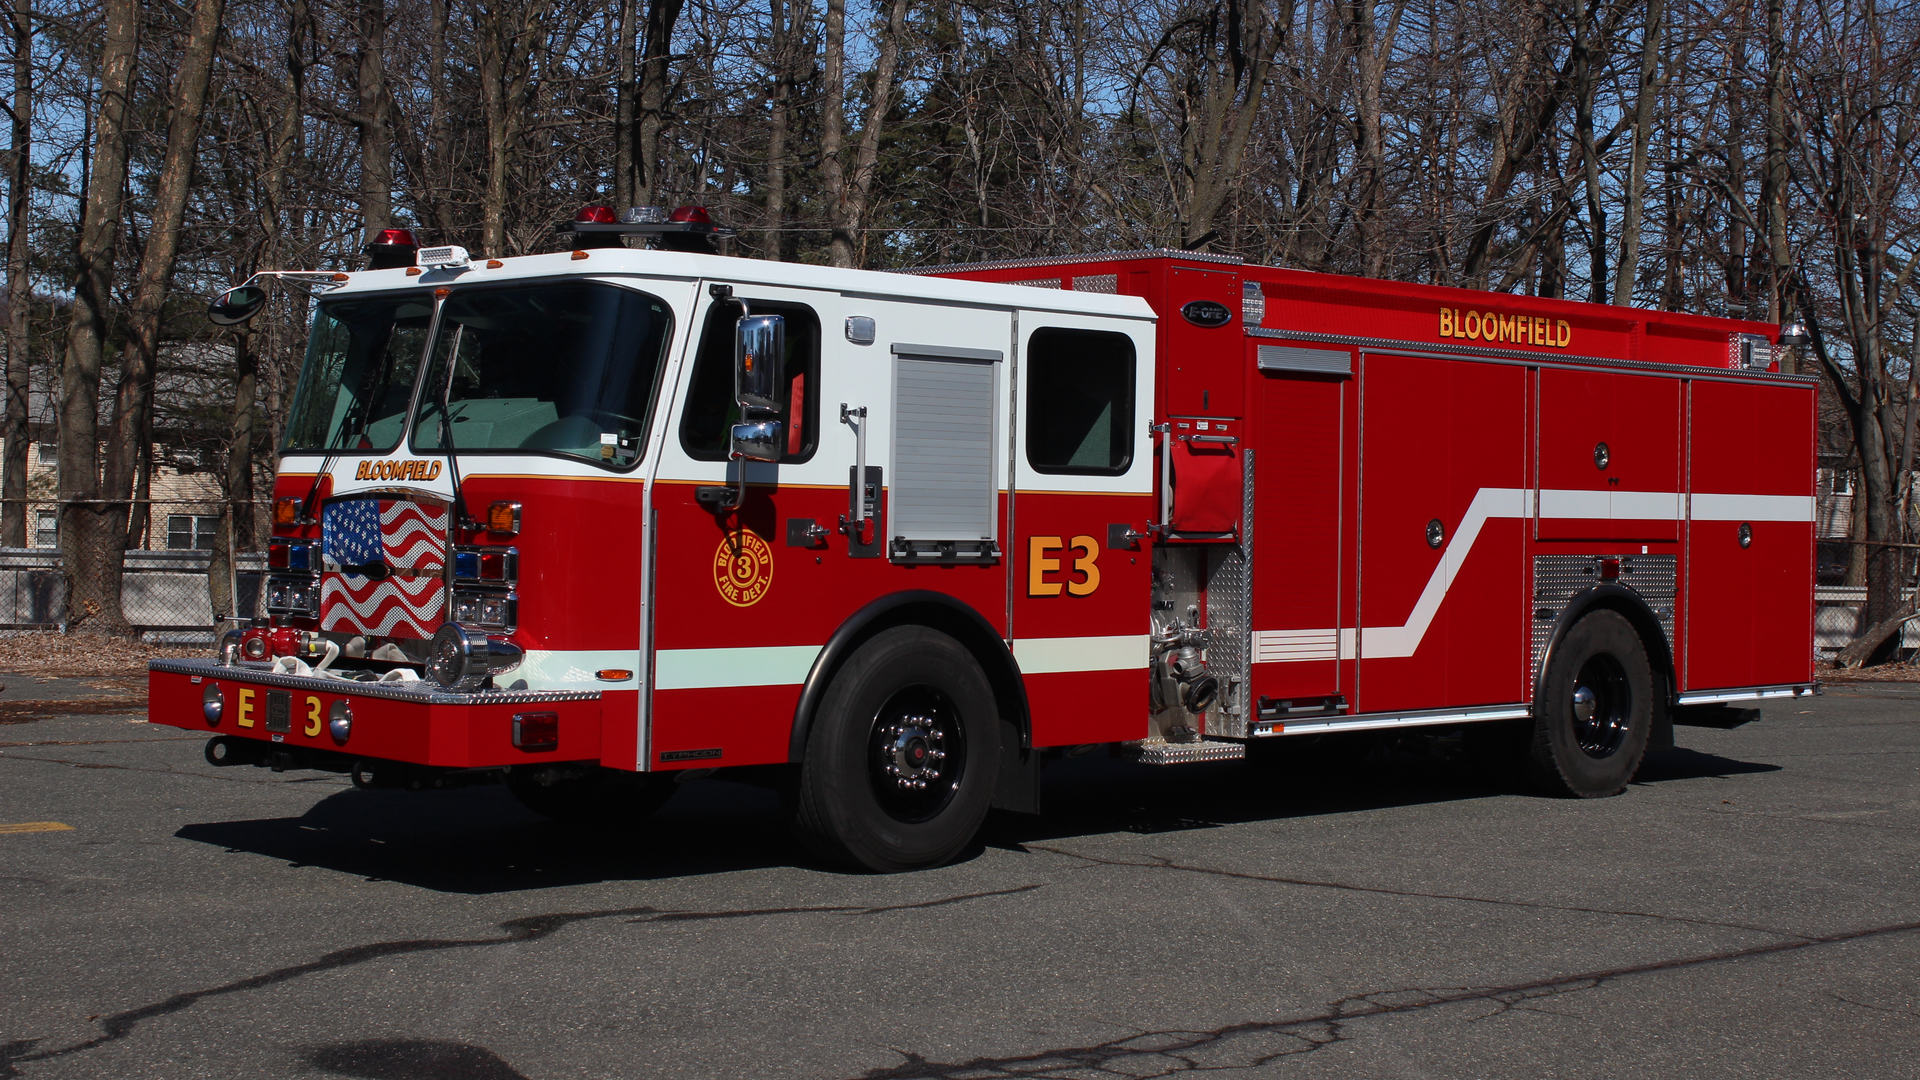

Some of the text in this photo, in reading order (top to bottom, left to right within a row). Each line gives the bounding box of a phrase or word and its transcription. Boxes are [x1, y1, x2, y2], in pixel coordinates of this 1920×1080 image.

[1439, 307, 1571, 348] BLOOMFIELD
[355, 460, 442, 481] BLOOMFIELD
[737, 556, 752, 579] 3
[1027, 535, 1100, 598] E3
[719, 575, 768, 602] FIRE DEPT.
[238, 688, 322, 737] E 3
[661, 750, 721, 759] TYPHOON
